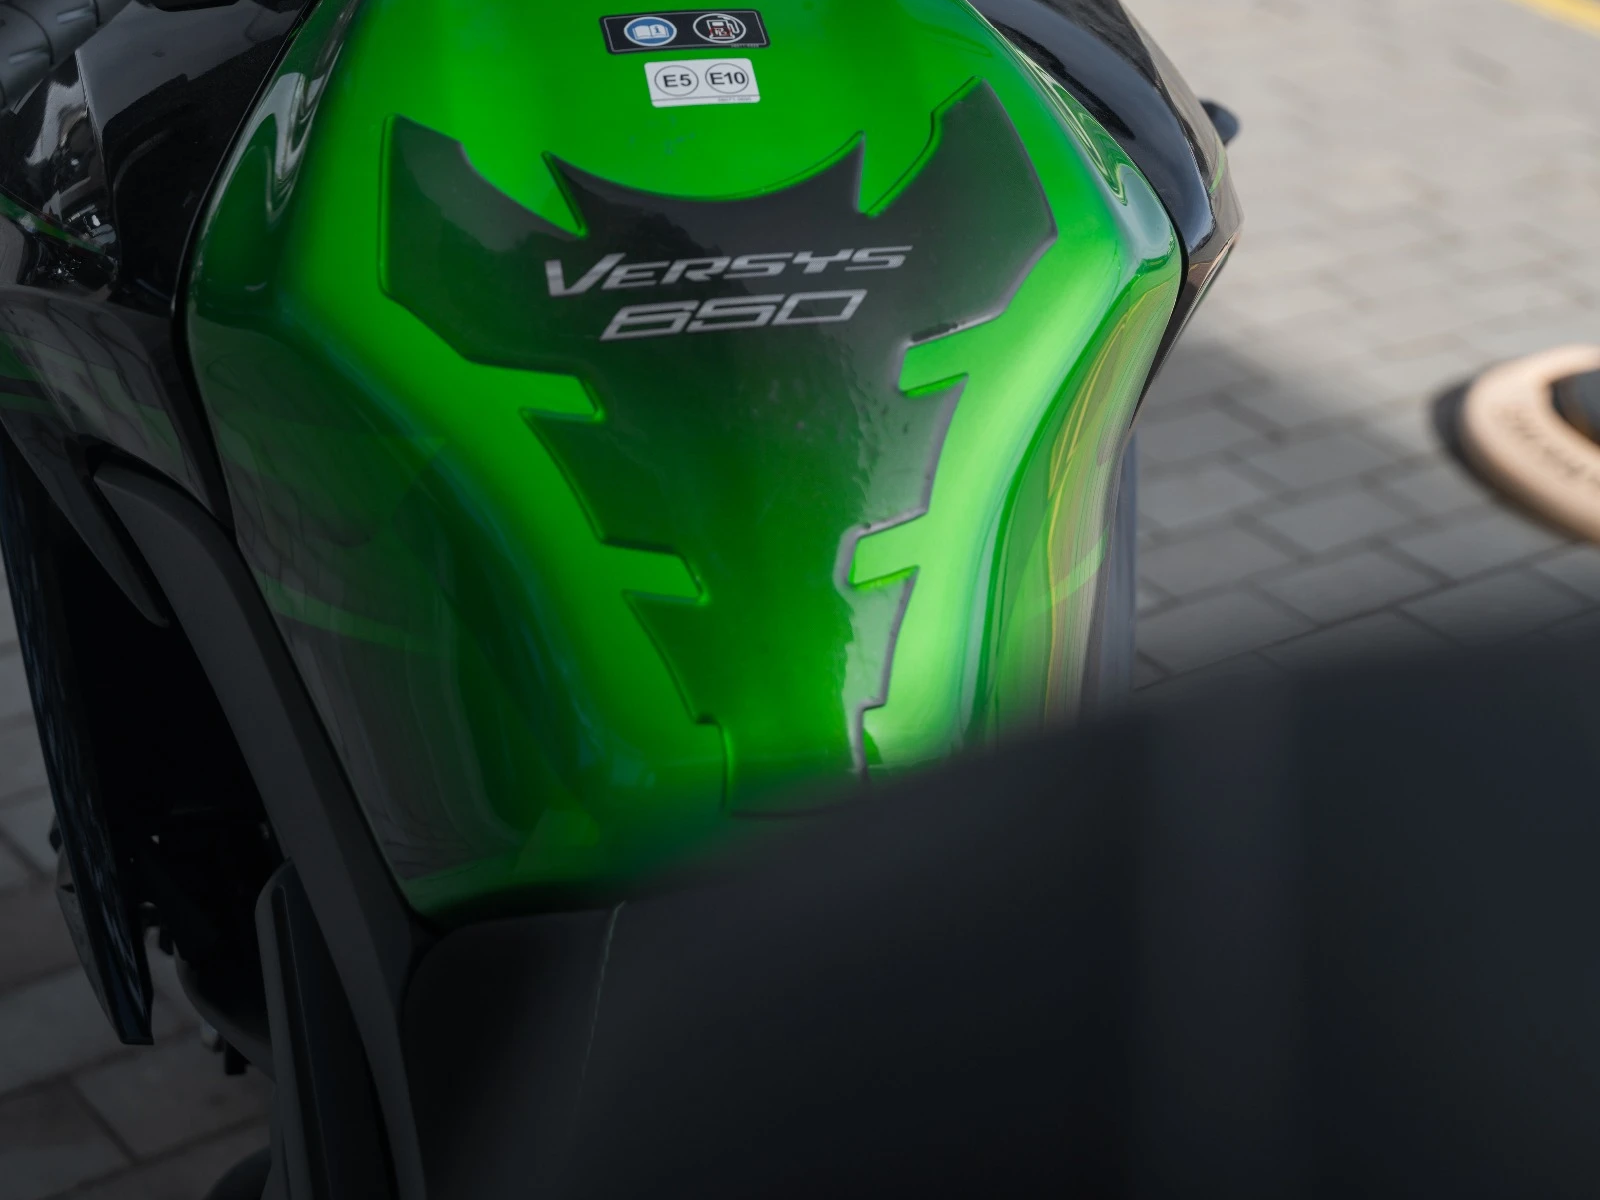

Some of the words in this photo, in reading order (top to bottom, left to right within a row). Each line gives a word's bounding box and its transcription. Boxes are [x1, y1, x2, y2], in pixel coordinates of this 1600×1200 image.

[663, 74, 692, 88] E5
[710, 72, 746, 85] E10
[545, 244, 913, 298] VERSYS
[599, 288, 867, 341] 650
